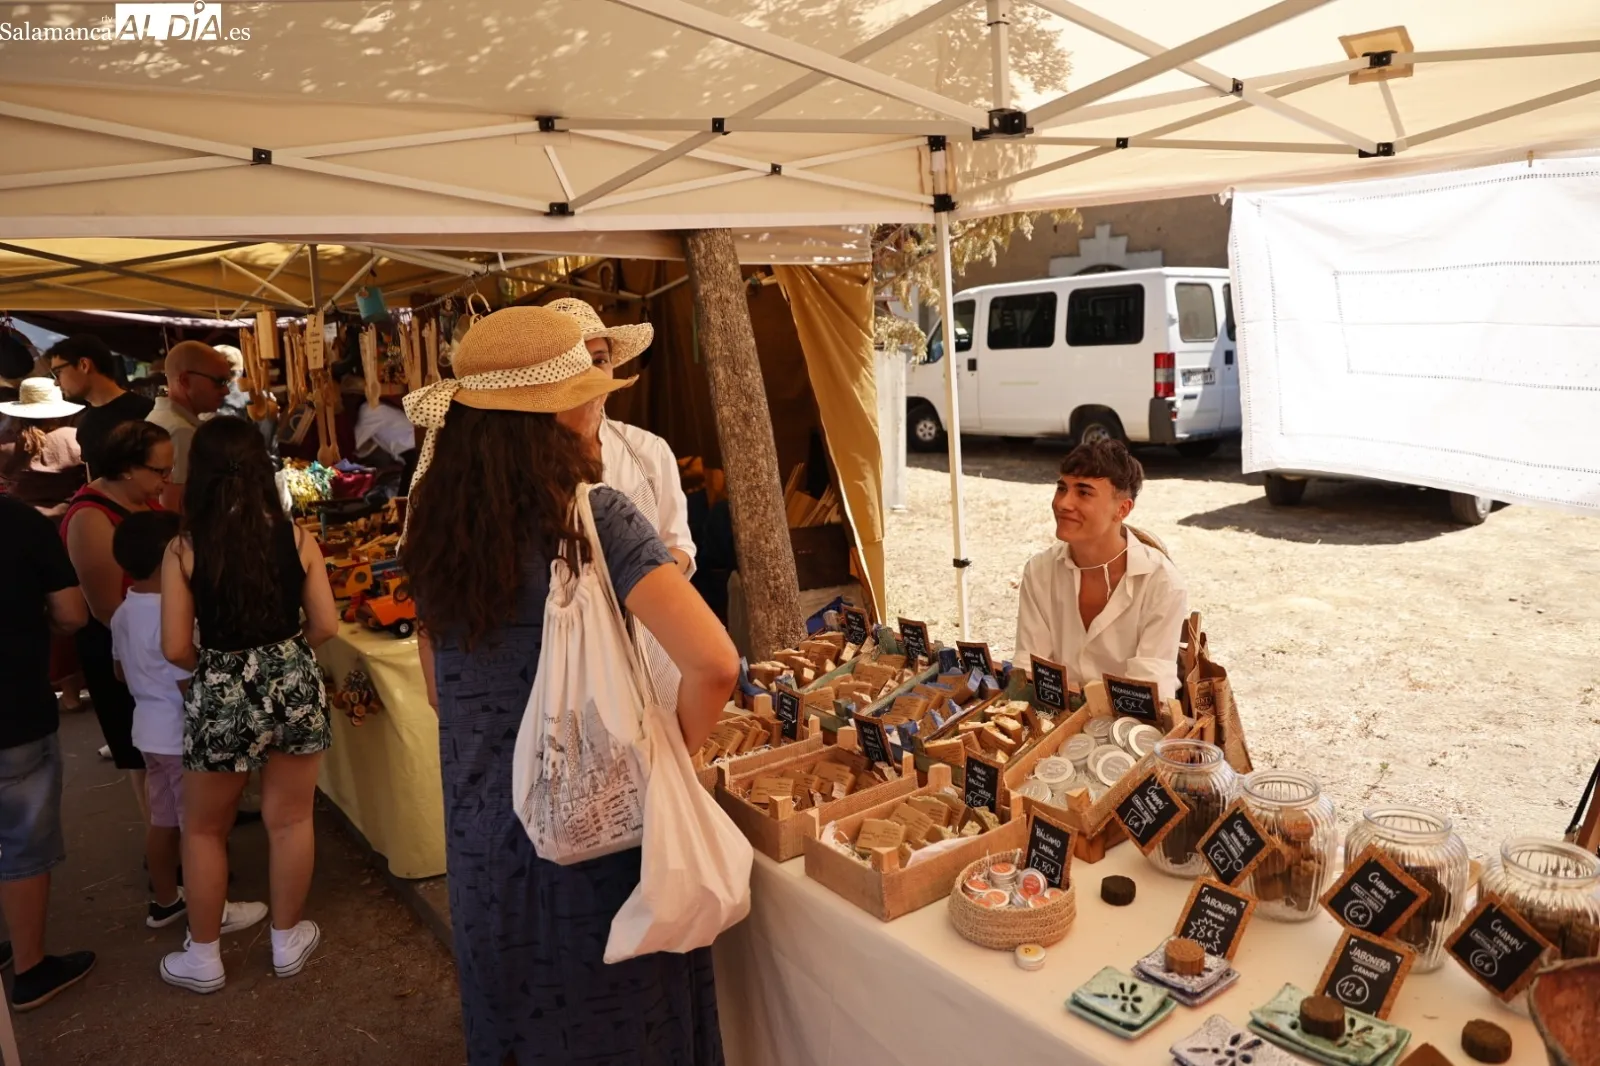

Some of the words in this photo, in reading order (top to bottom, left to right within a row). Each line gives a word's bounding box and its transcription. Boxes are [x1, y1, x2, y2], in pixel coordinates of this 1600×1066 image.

[1128, 815, 1141, 829] 6€
[1033, 857, 1056, 875] 2,50€
[1213, 849, 1226, 865] 6€
[1368, 872, 1401, 900] CHAMPÚ
[1200, 894, 1238, 917] JABONERA
[1349, 904, 1367, 923] 6€
[1196, 925, 1215, 939] 8€
[1490, 919, 1528, 952] CHAMPÚ
[1349, 946, 1391, 973] JABONERA
[1474, 953, 1493, 972] 6€
[1352, 964, 1380, 981] GRANDE
